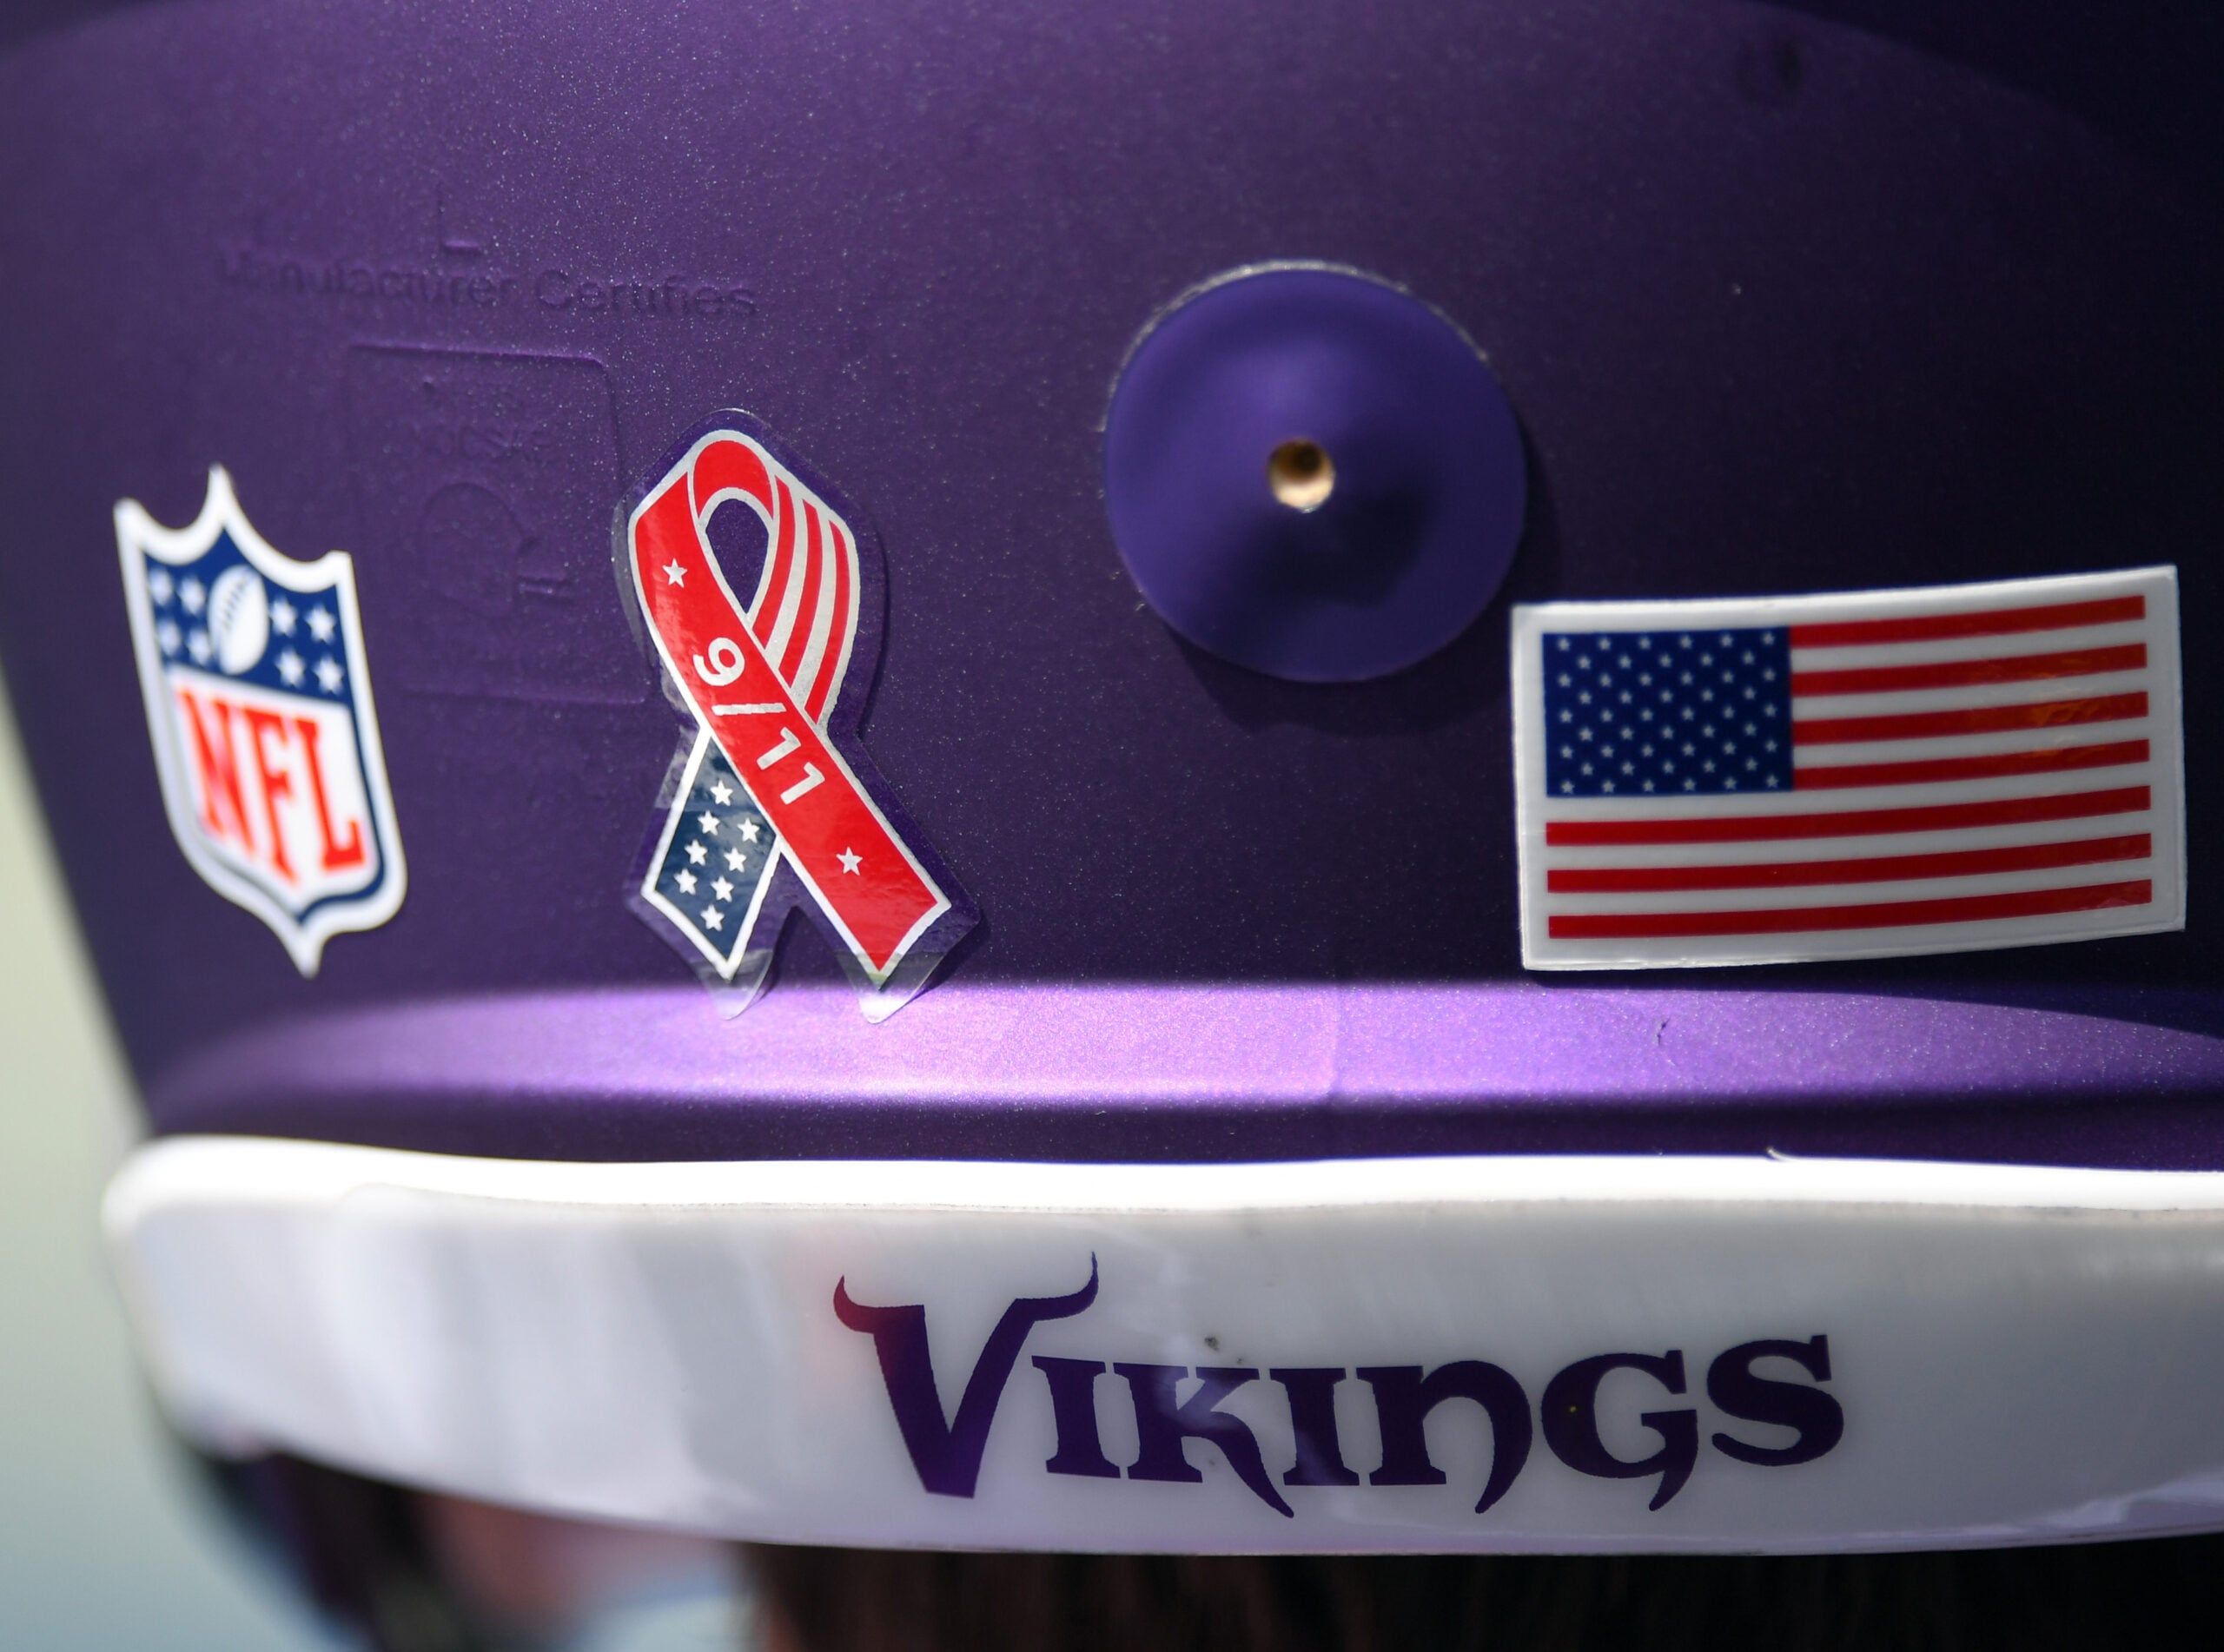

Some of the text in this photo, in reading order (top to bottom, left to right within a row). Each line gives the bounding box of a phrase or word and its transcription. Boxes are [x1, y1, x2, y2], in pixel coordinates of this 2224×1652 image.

[179, 691, 365, 884] NFL
[693, 637, 825, 805] 9/11
[833, 1252, 1844, 1519] VIKINGS
